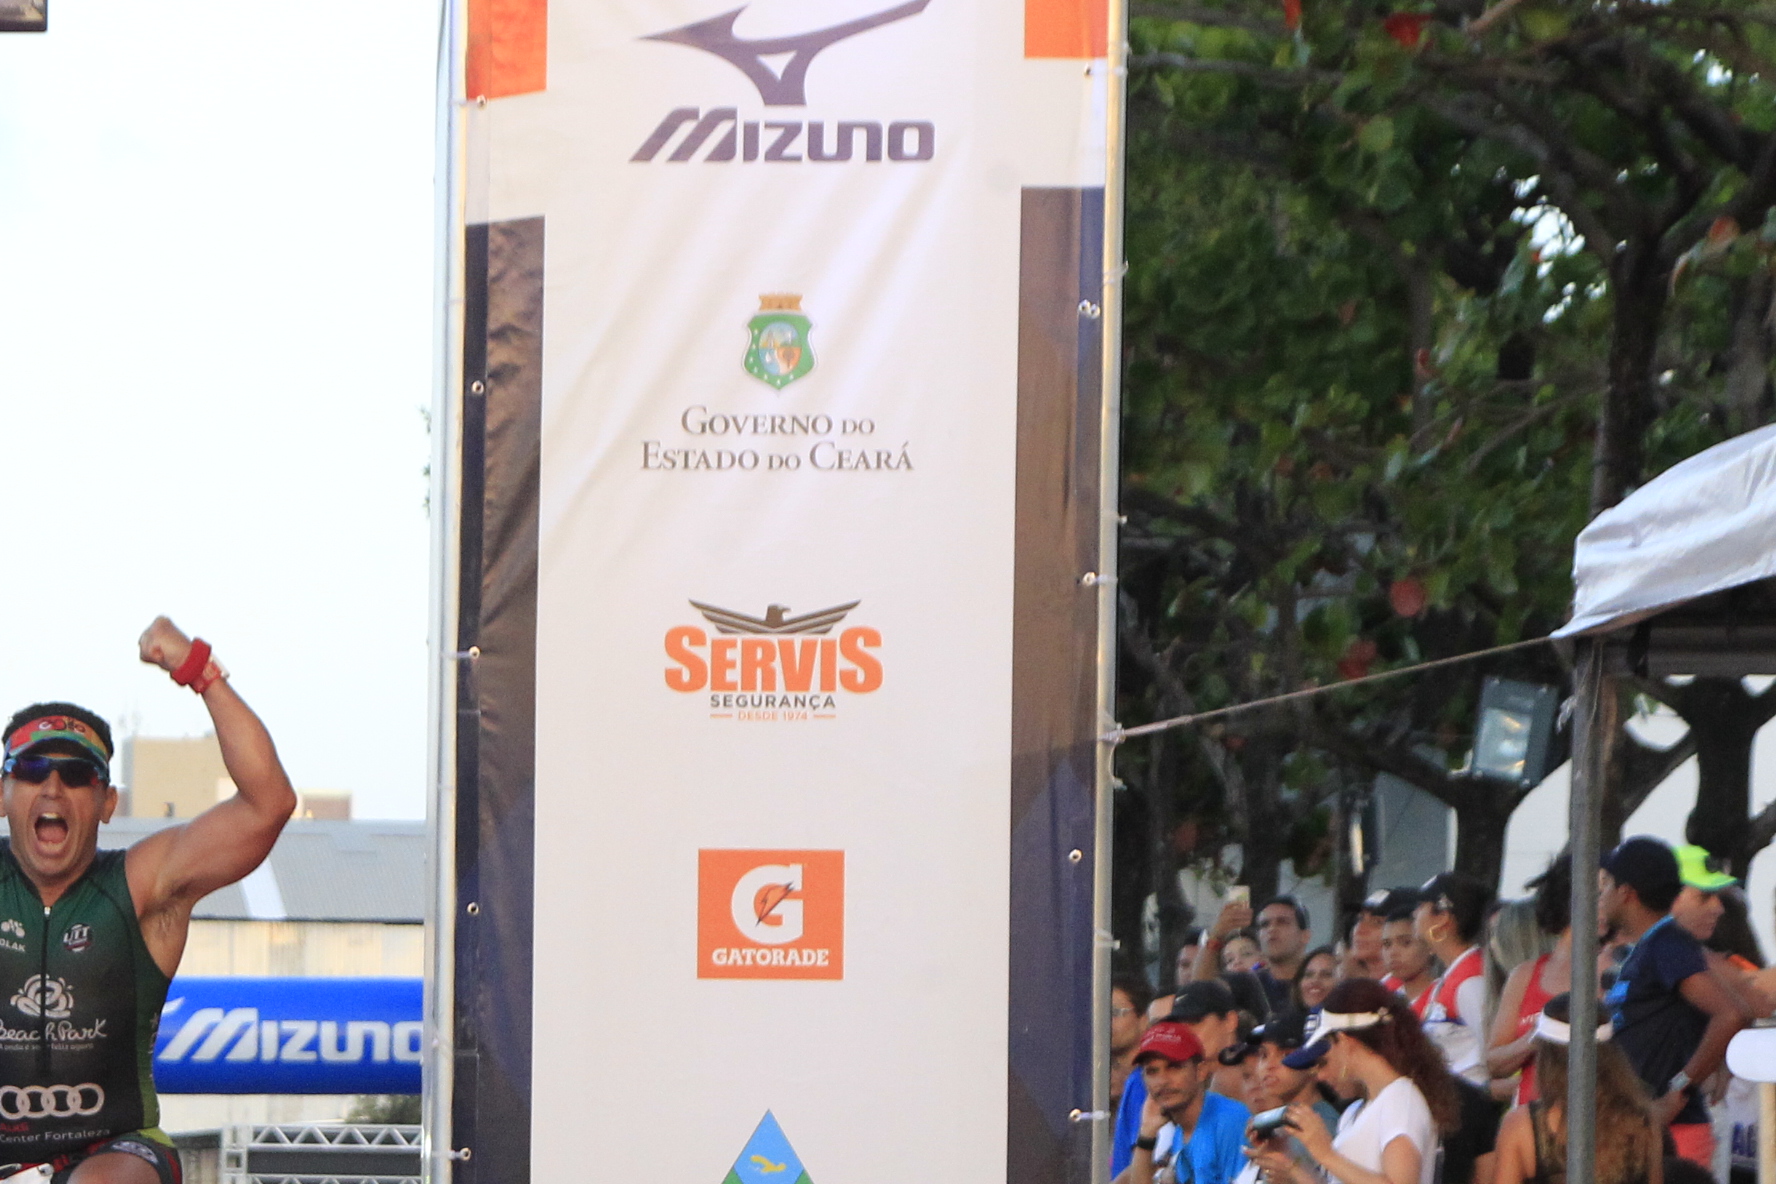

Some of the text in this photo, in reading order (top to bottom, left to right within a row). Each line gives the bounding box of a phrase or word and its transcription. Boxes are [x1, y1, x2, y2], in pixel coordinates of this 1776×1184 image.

[664, 625, 883, 694] SERVIS
[710, 694, 836, 710] SEGURANÇA
[738, 711, 808, 721] DESDE 1974
[712, 948, 829, 966] GATORADE
[0, 1129, 110, 1143] Center Fortaleza
